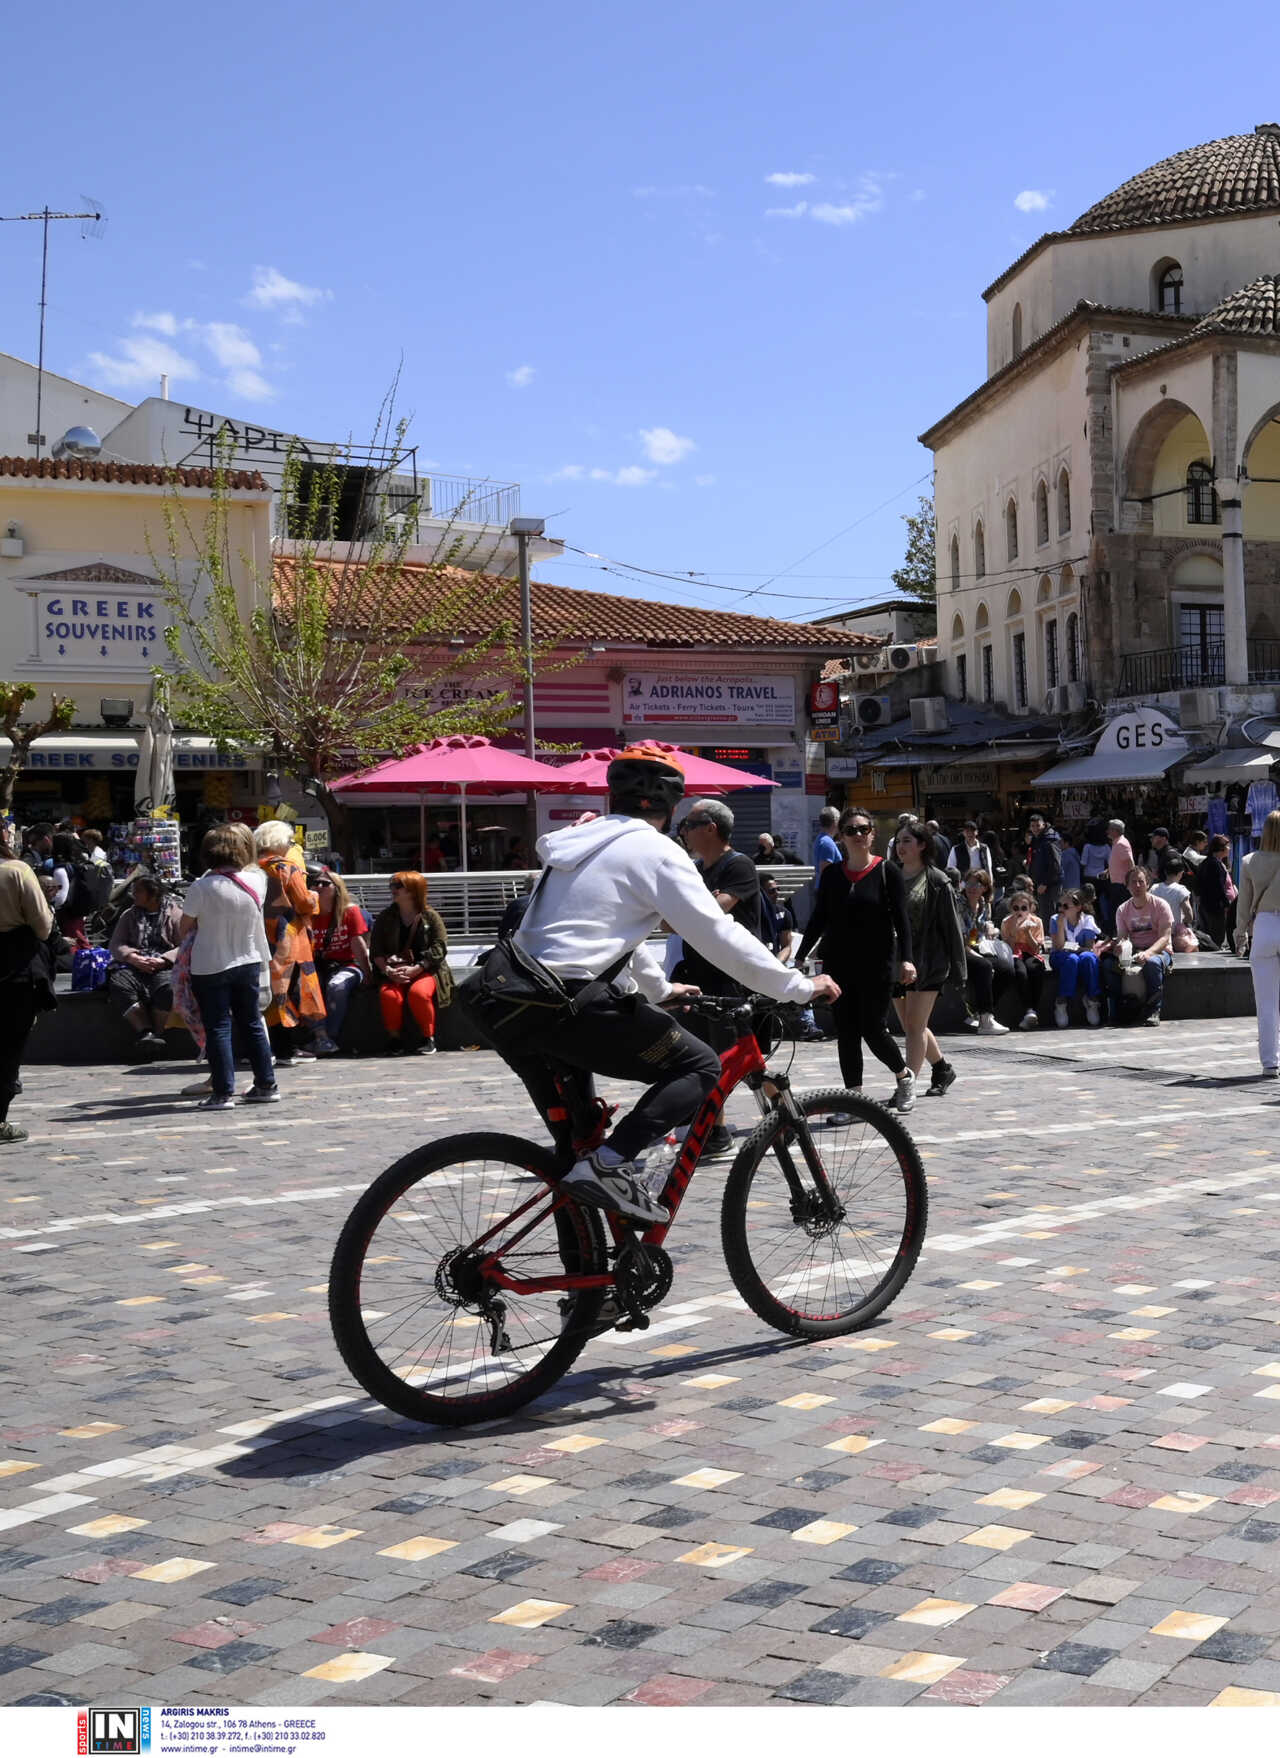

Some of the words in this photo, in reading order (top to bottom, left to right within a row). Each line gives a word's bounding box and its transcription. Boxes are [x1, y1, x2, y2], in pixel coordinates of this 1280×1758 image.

[47, 600, 155, 618] GREEK
[46, 622, 157, 641] SOUVENIRS
[650, 685, 722, 699] ADRIANOS
[728, 686, 777, 700] TRAVEL
[630, 703, 640, 711] Air
[643, 703, 670, 711] Tickets
[678, 703, 698, 712] Ferry
[700, 703, 726, 711] Tickets
[732, 704, 754, 712] Tours
[815, 729, 837, 738] ATM
[1116, 722, 1163, 749] GES
[26, 753, 96, 767] REEK
